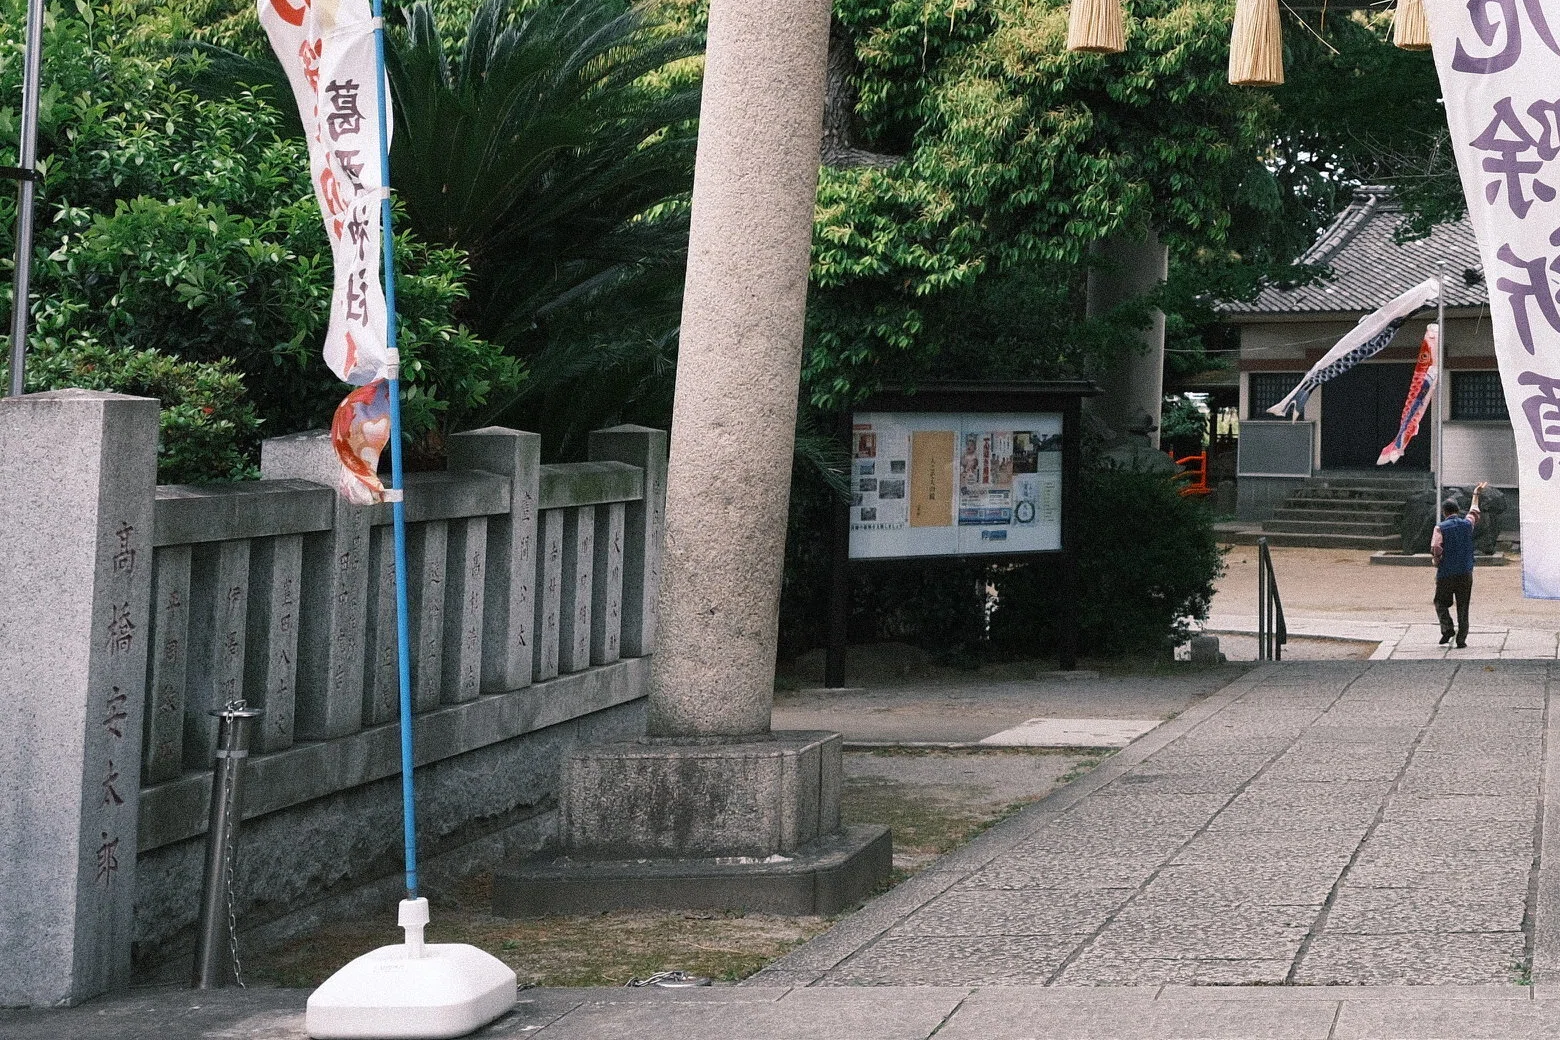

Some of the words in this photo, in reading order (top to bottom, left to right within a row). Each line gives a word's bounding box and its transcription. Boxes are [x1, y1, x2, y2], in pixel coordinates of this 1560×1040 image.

[95, 521, 137, 888] 高橋安太郎
